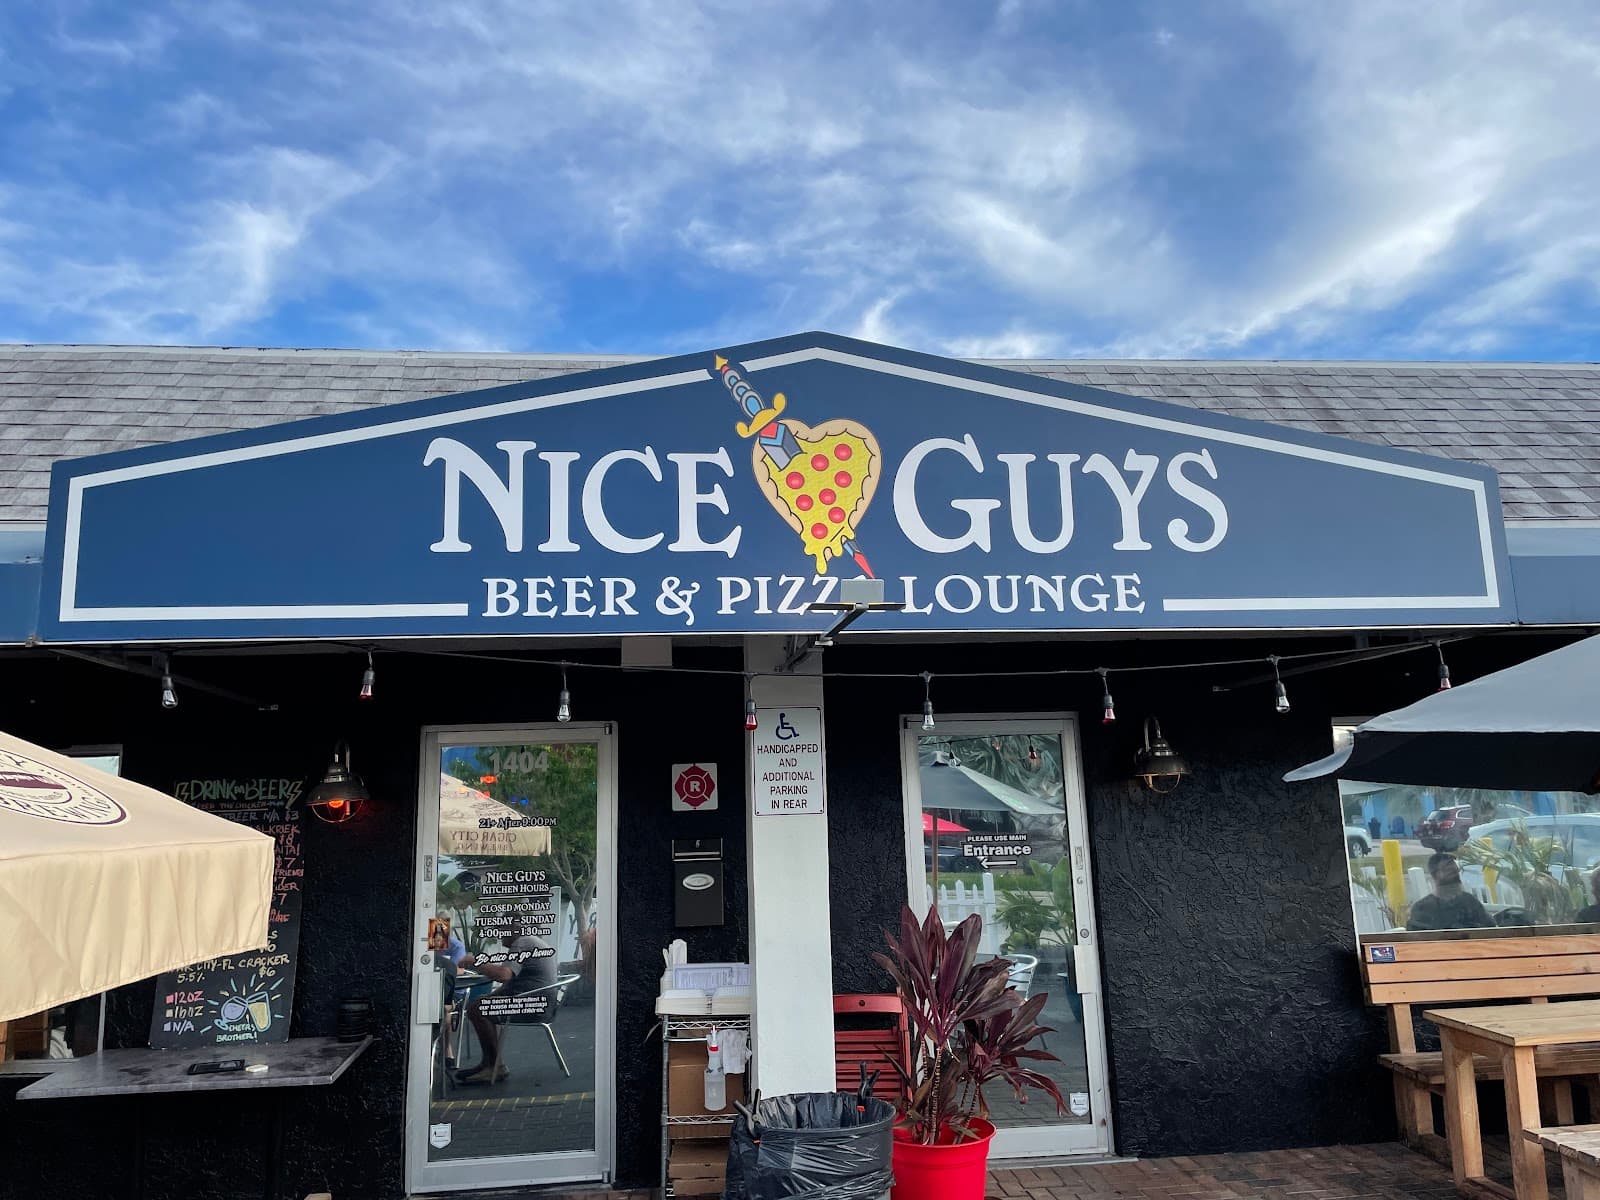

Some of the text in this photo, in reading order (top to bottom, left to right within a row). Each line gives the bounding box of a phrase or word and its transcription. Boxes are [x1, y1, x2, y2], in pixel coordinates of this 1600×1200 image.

[423, 433, 1229, 559] NICE GUYS
[481, 573, 1146, 626] BEER & PIZZ LOUNGE
[757, 743, 819, 754] HANDICAPPED
[487, 751, 550, 775] 1404
[778, 758, 798, 768] AND
[762, 771, 815, 782] ADDITIONAL
[190, 779, 236, 801] DRINK
[245, 779, 289, 801] BEER
[689, 780, 701, 793] R
[770, 785, 808, 796] PARKING
[771, 799, 808, 809] IN REAR
[479, 818, 497, 829] 21+
[498, 817, 521, 830] After
[963, 844, 1032, 856] Entrance
[486, 870, 546, 884] NICE GUYS
[482, 883, 549, 895] KITCHEN HOURS
[480, 902, 551, 913] CLOSED MONDAY
[475, 916, 513, 927] TUESDAY
[520, 914, 556, 925] SUNDAY
[479, 928, 512, 938] 4:00pm
[520, 926, 552, 936] 1:30am
[238, 954, 291, 969] CRACKER
[474, 947, 555, 967] Be nice or go home
[259, 966, 277, 979] $6
[172, 1019, 195, 1035] N/A
[228, 1023, 256, 1032] CHEERS
[215, 1031, 258, 1043] BROTHER!
